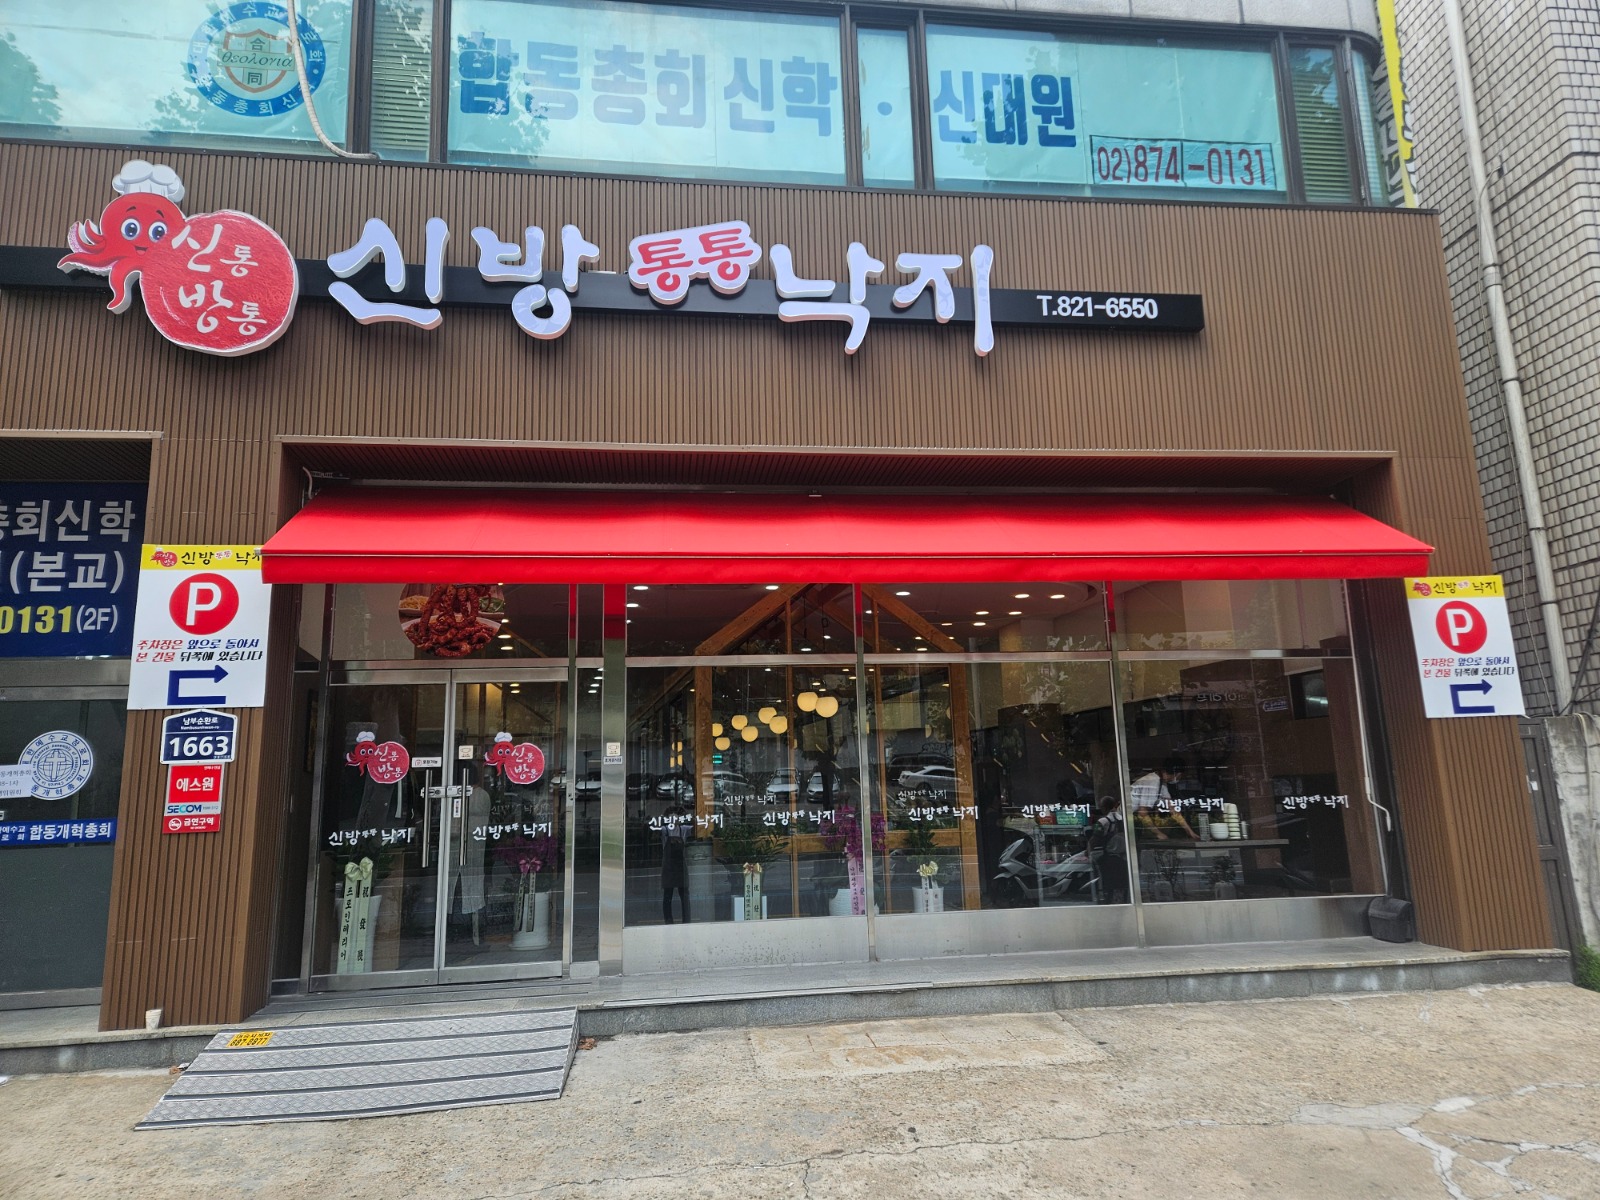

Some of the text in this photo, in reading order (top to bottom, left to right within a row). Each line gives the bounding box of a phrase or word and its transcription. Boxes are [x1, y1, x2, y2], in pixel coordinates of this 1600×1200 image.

[250, 37, 266, 51] 合
[247, 72, 262, 86] 同
[933, 69, 1077, 148] 신대원
[327, 217, 994, 356] 신방 통통 낙지
[1036, 295, 1158, 319] T.821-6550
[0, 499, 136, 543] 회신학
[181, 551, 215, 566] 신방
[9, 550, 124, 594] (본교)
[1433, 581, 1457, 594] 신방
[1472, 581, 1497, 594] 낙지
[186, 582, 222, 626] P
[76, 604, 119, 634] (2F)
[1445, 608, 1473, 647] P
[136, 638, 260, 650] 주차장은 앞으로 돌아서
[136, 650, 263, 663] 본 건물 뒤쪽에 있습니다
[1421, 656, 1510, 668] 주차장은 앞으로 돌아서
[1435, 668, 1451, 678] 건물
[1482, 666, 1515, 676] 있습니다
[182, 717, 219, 726] 남부순환로
[169, 736, 229, 757] 1663
[176, 777, 214, 792] 에스원
[167, 804, 202, 814] SECOM
[184, 817, 214, 826] 금연구역
[0, 822, 111, 841] 예수교 합동개혁총회
